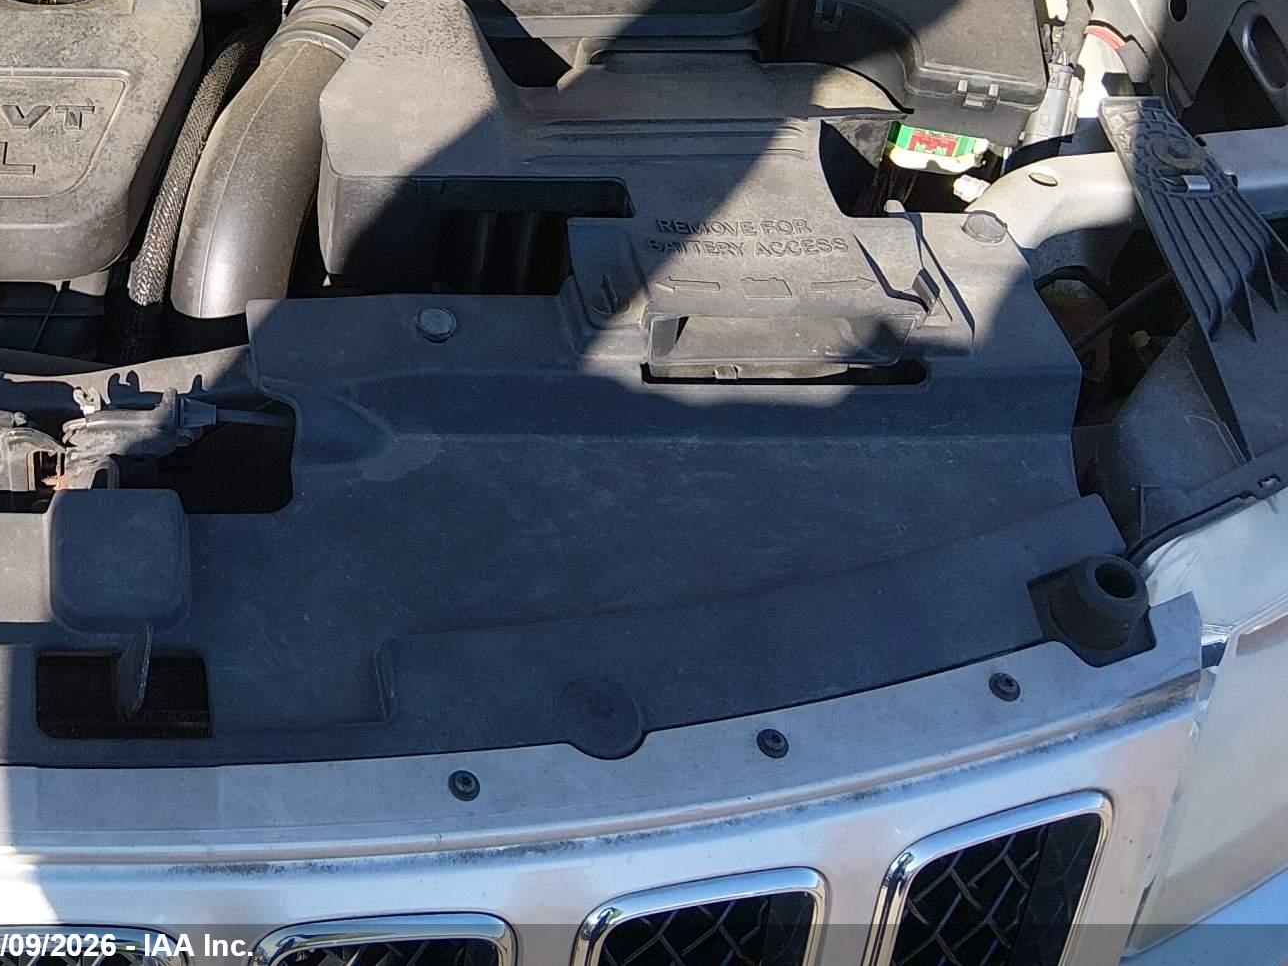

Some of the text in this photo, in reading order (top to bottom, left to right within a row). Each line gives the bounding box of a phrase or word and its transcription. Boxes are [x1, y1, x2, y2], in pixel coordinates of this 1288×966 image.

[656, 218, 812, 236] REMOVE FOR
[647, 237, 849, 258] BATTERY ACCESS
